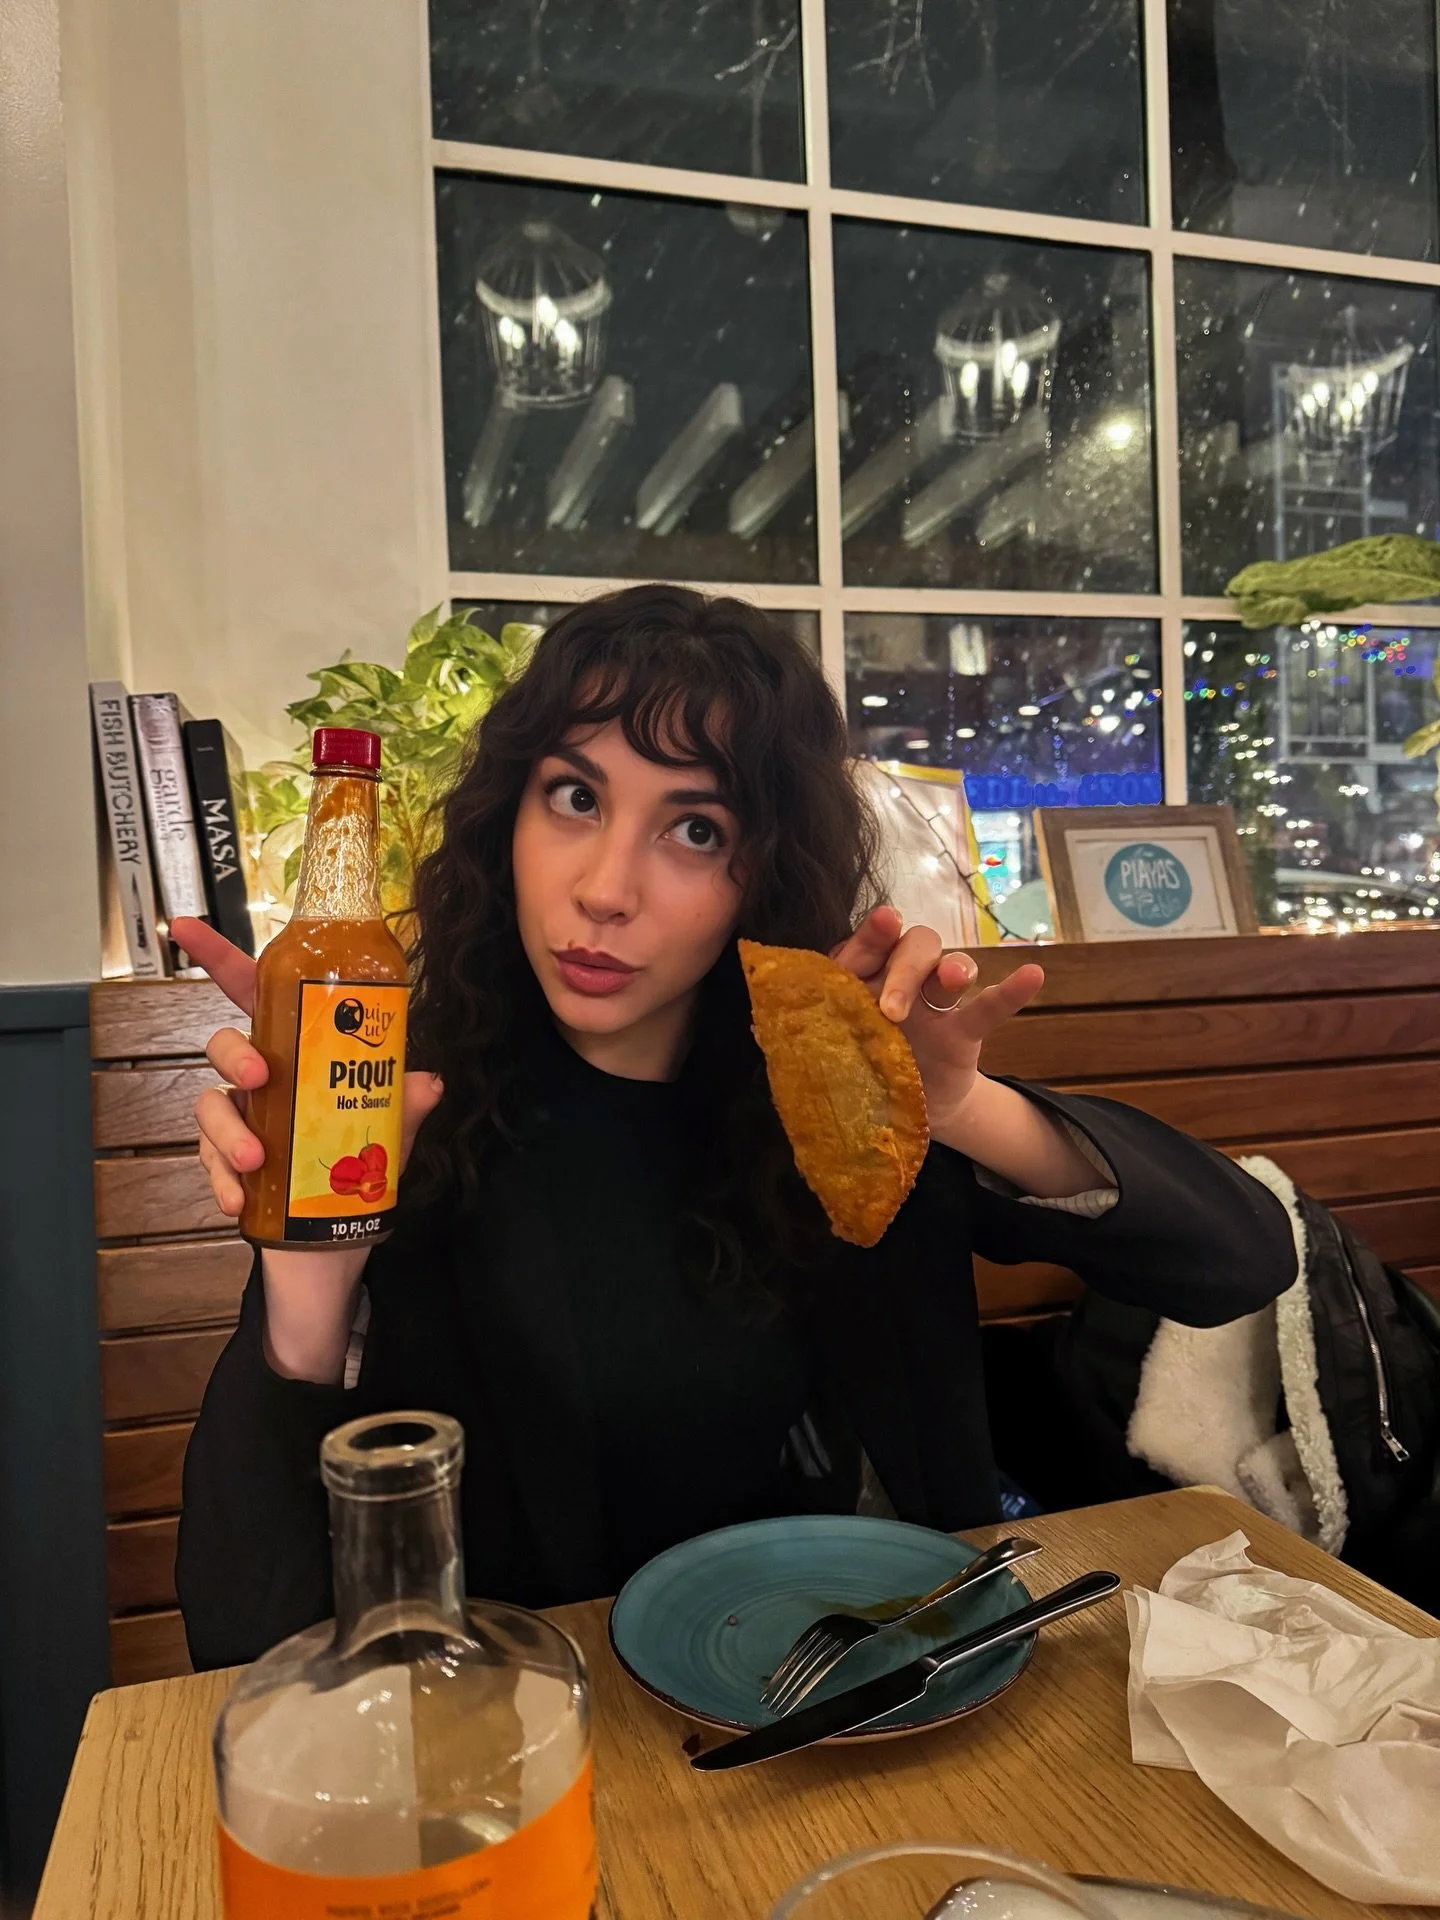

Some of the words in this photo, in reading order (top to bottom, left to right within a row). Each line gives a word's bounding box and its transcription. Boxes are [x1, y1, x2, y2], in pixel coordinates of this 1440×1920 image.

[99, 699, 126, 747] FISH
[106, 752, 142, 866] BUTCHERY
[202, 798, 239, 883] MASA
[337, 1096, 359, 1111] Hot
[331, 1223, 347, 1236] 10
[349, 1221, 364, 1235] FL
[365, 1218, 381, 1232] OZ
